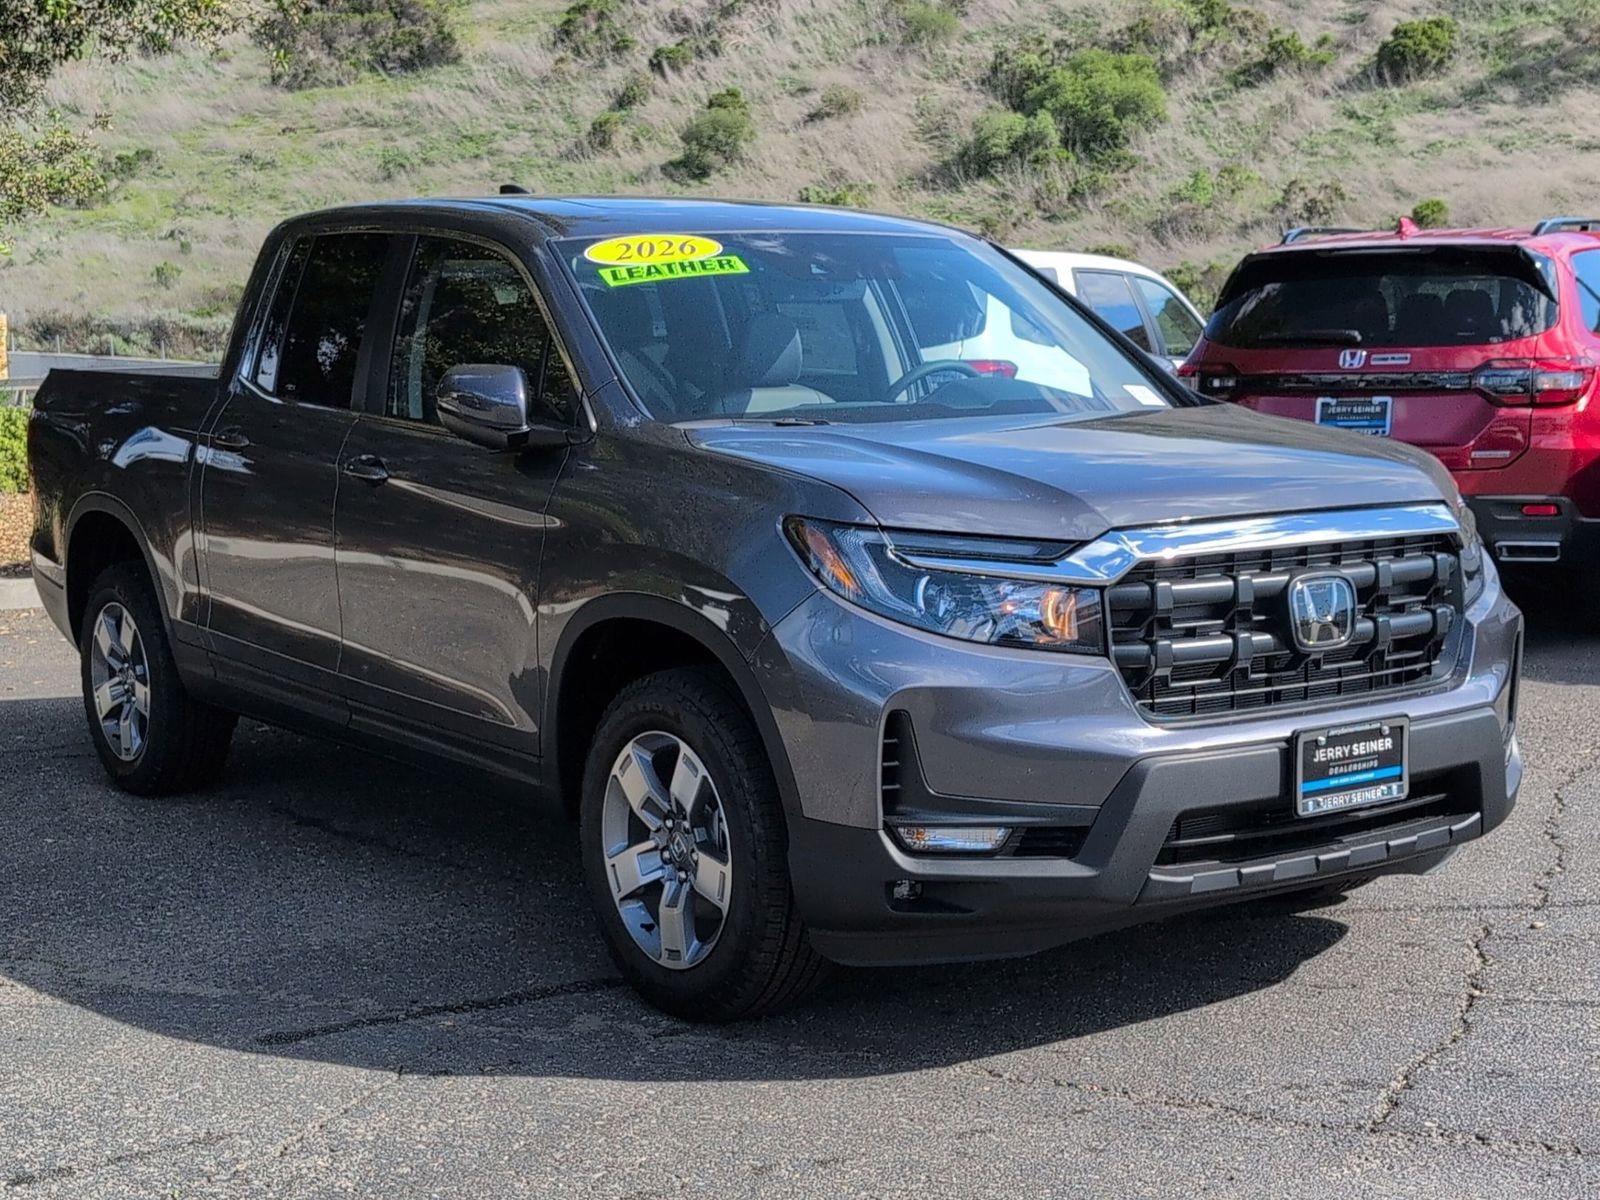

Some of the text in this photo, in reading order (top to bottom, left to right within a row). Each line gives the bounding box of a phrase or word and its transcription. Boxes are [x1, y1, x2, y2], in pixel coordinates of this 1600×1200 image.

[616, 239, 697, 261] 2026
[609, 258, 735, 282] LEATHER
[1328, 405, 1381, 414] JERRY SEINER
[1313, 738, 1393, 762] JERRY SEINER
[1328, 760, 1378, 775] DEALERSHIPS
[1322, 788, 1382, 808] JERRY SEINER
